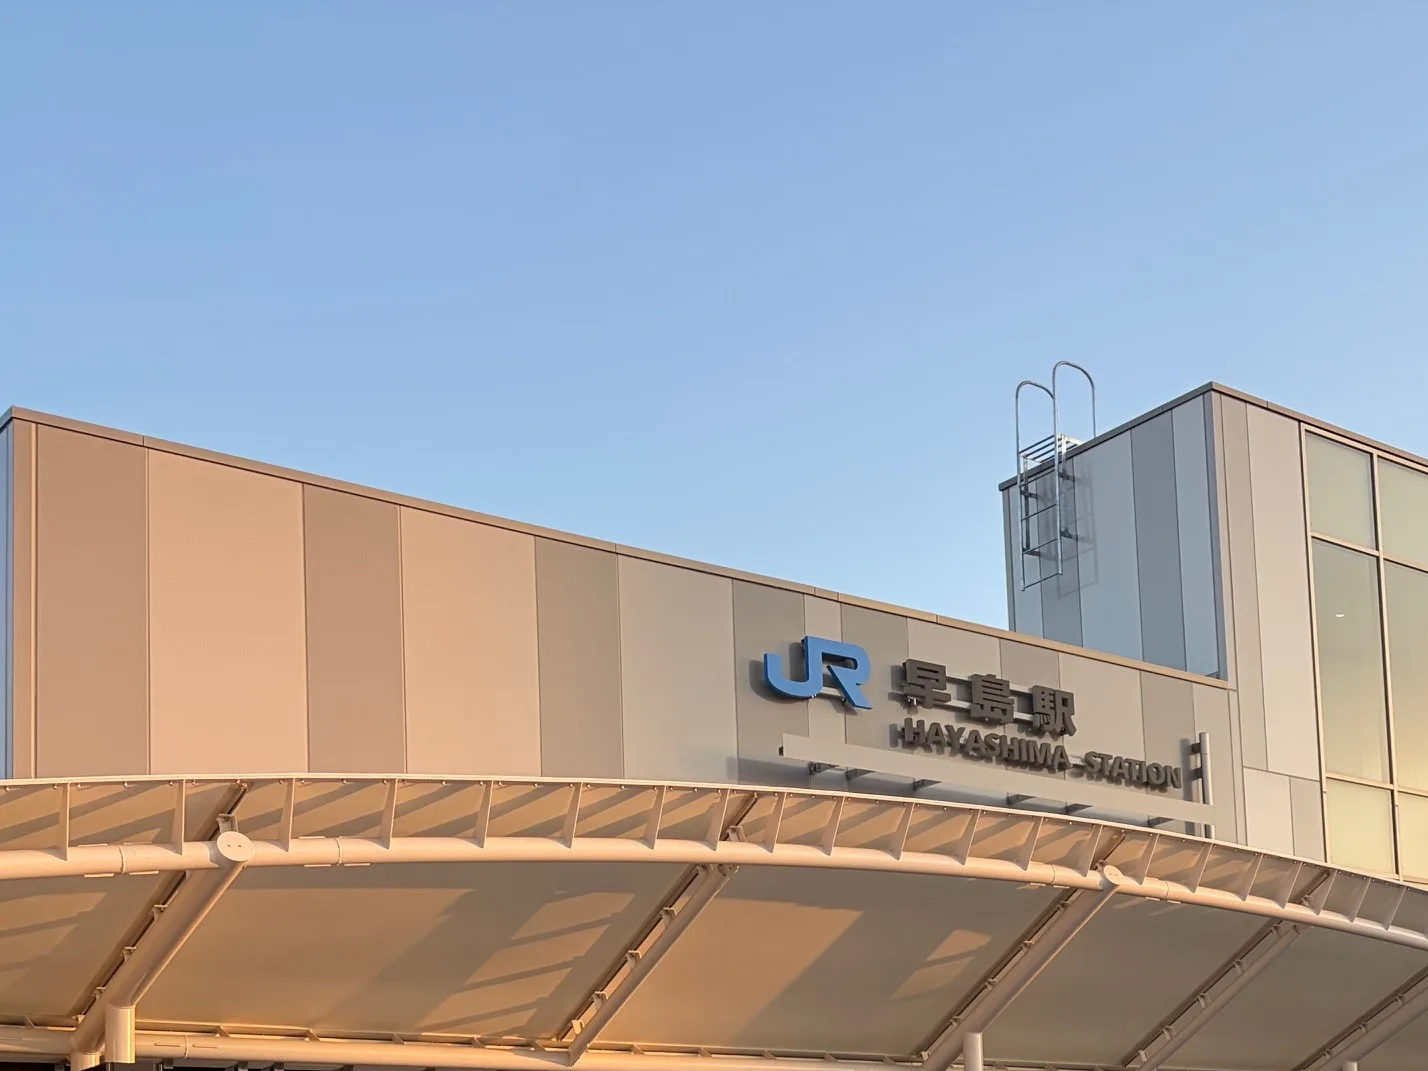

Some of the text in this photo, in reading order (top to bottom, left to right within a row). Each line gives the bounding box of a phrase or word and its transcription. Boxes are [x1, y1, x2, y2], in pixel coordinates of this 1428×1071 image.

[763, 635, 873, 710] JR
[901, 658, 1077, 737] 早島駅
[902, 717, 1183, 789] HAYASHIMA STATION
